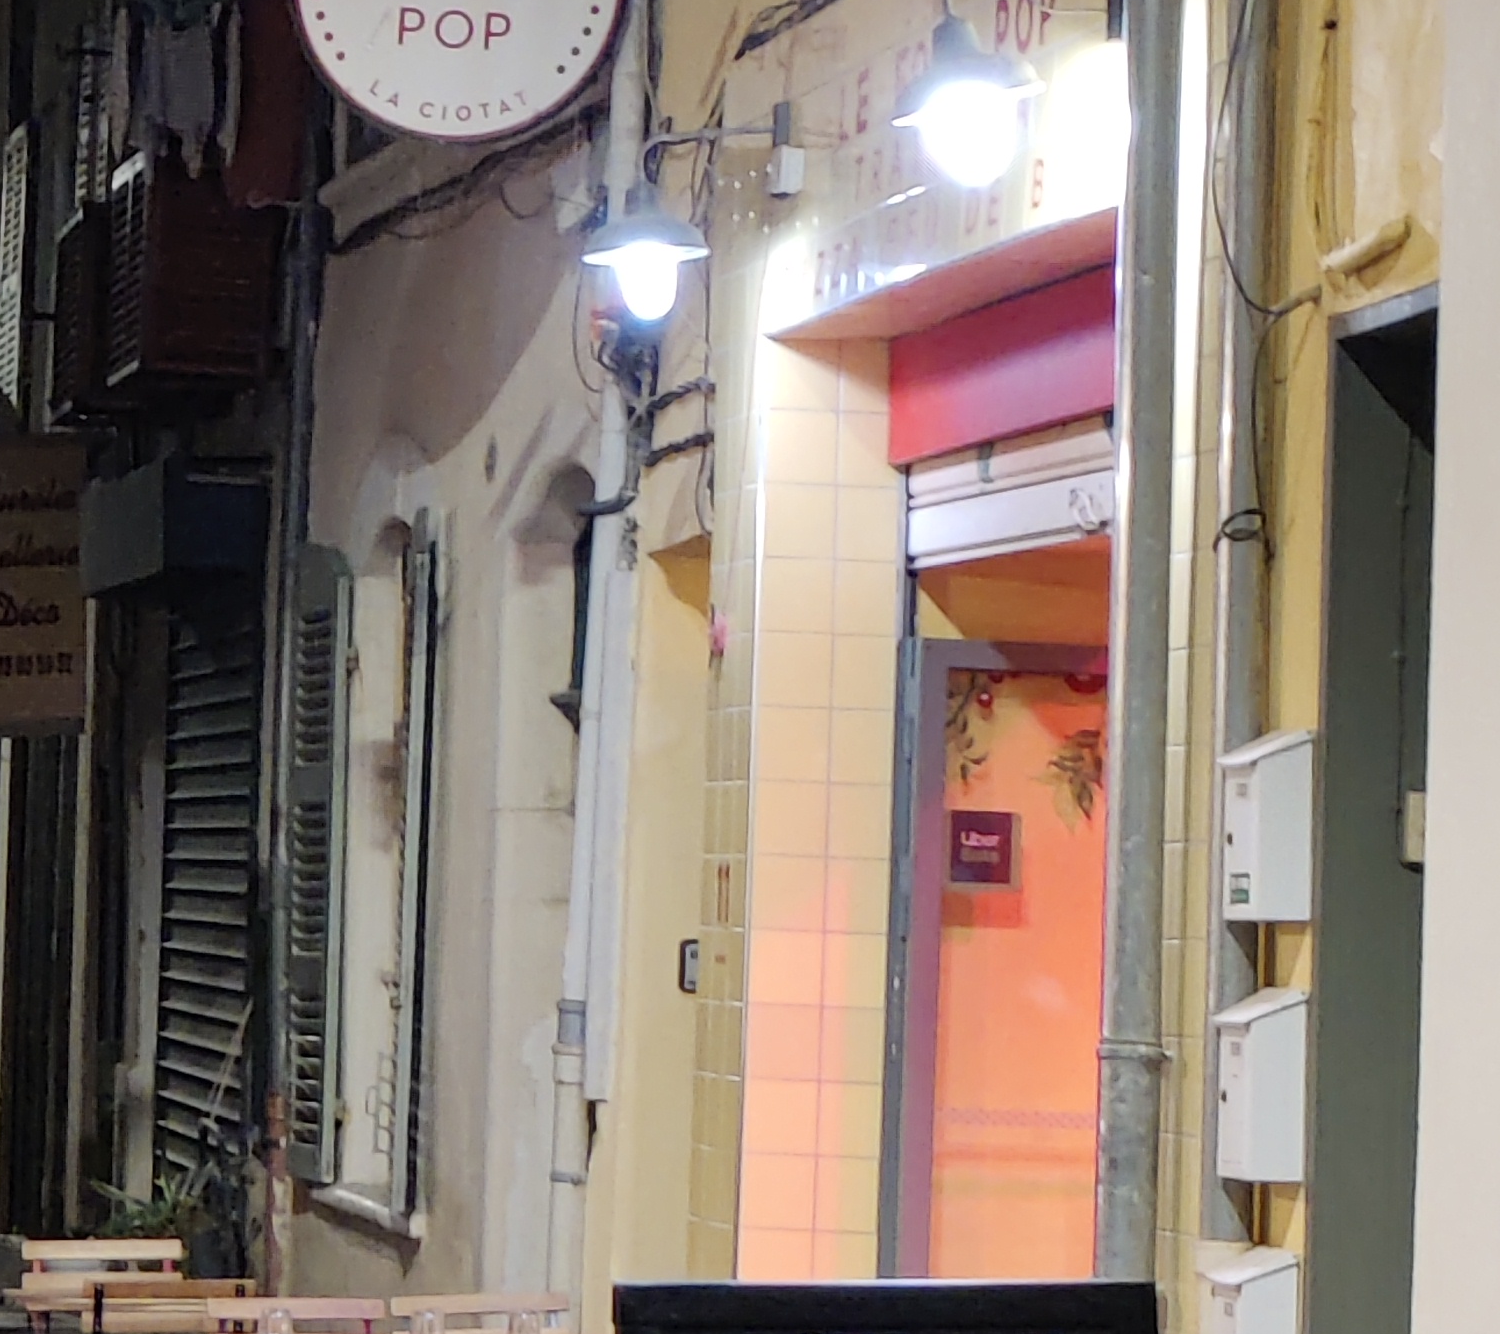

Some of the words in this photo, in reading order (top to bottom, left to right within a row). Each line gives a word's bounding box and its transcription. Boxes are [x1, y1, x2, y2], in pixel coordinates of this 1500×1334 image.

[397, 6, 512, 51] POP
[368, 78, 400, 108] LA
[418, 90, 530, 122] CIOTAT
